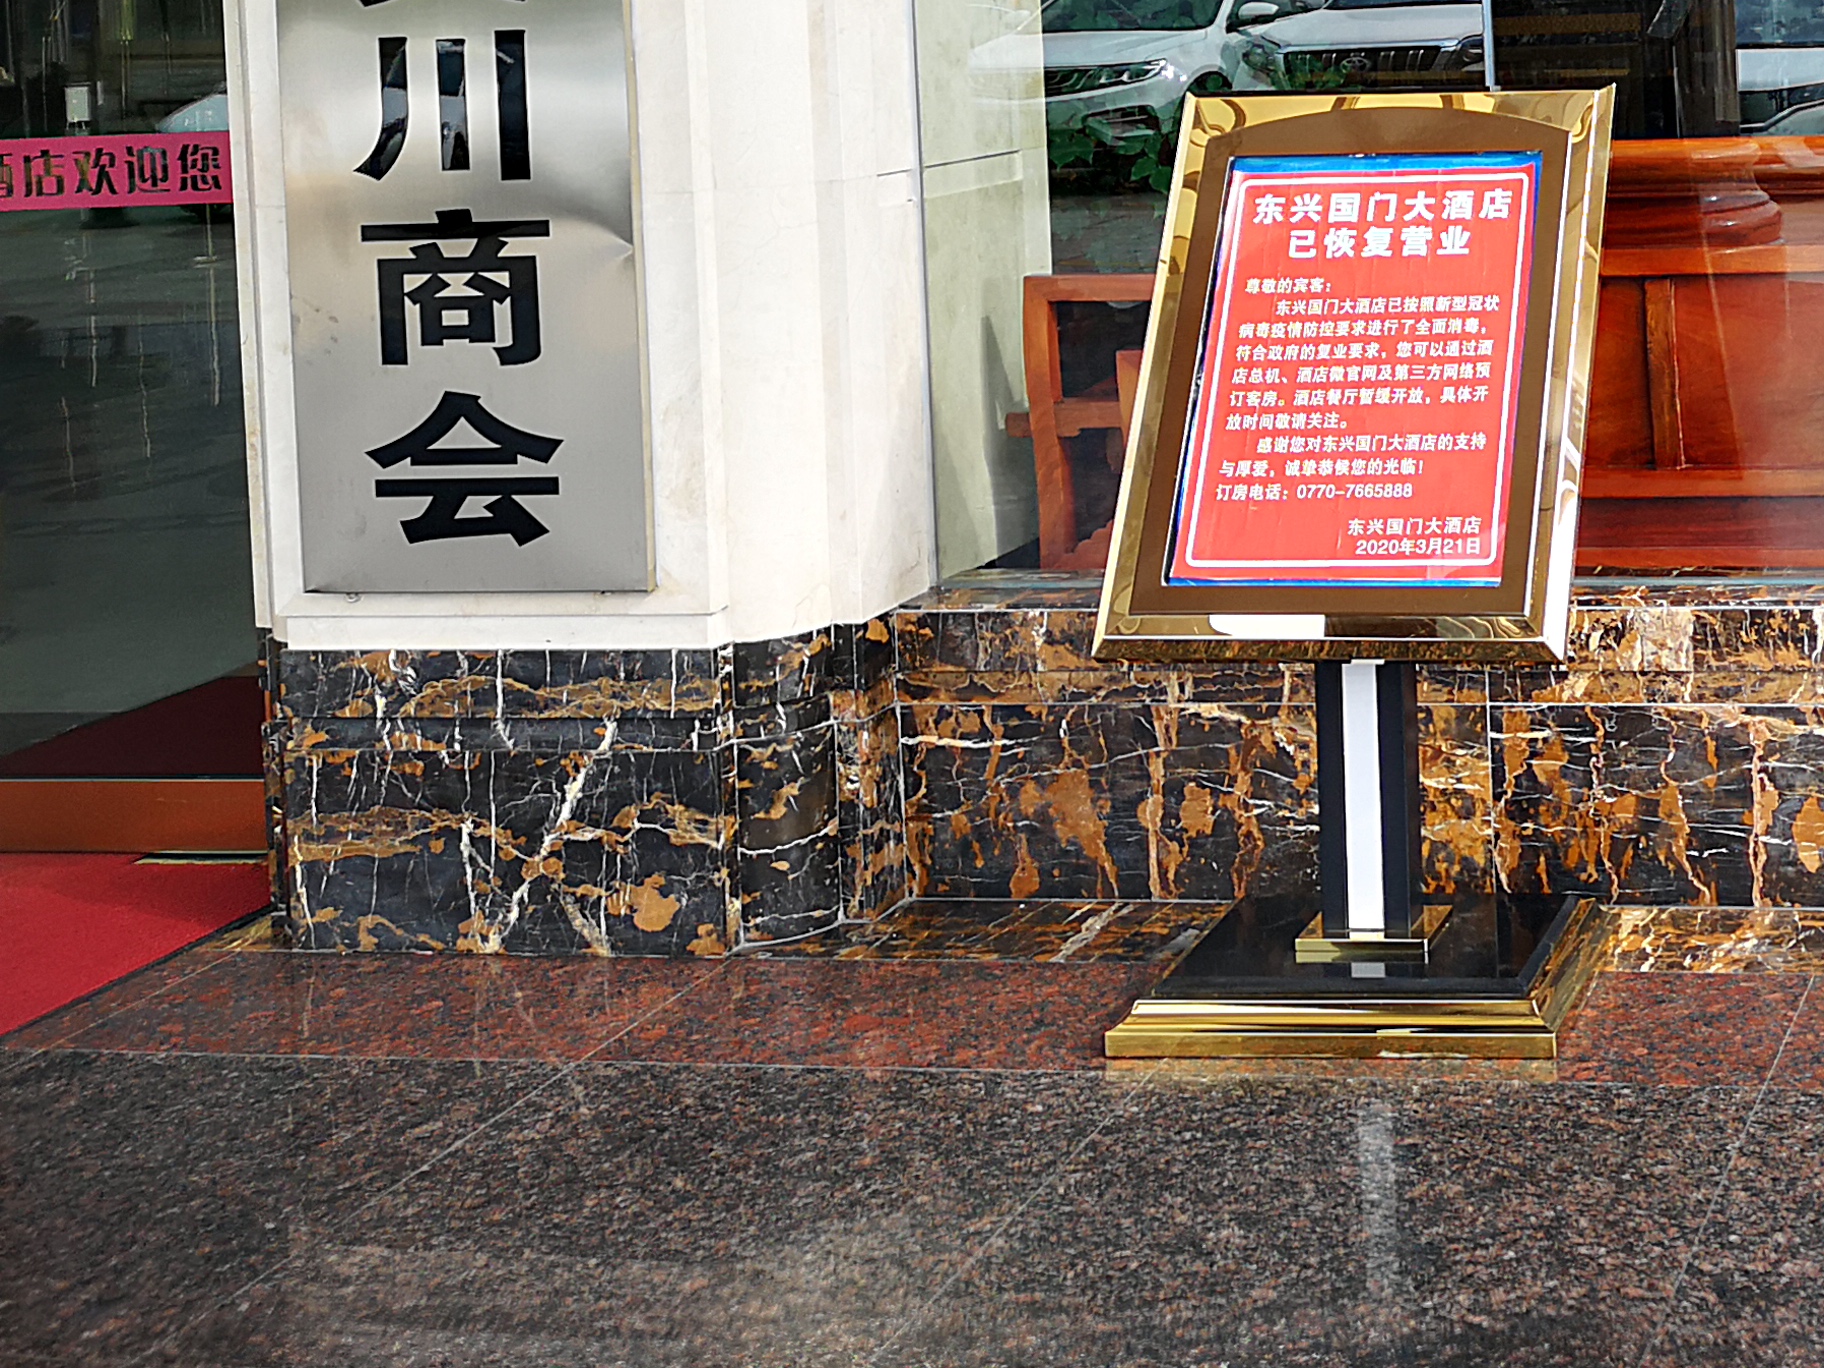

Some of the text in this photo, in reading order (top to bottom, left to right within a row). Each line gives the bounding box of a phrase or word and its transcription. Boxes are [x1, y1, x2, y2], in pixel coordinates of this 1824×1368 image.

[1252, 188, 1512, 225] 东兴国门大酒店
[1288, 225, 1471, 258] 已恢复营业
[1275, 294, 1501, 317] 东兴国门大酒店已按照新型冠状
[1256, 432, 1487, 454] 感谢您对东兴国门大酒店的支持
[1347, 515, 1483, 536] 东兴国门大酒店
[1355, 537, 1482, 556] 2020年3月21日
